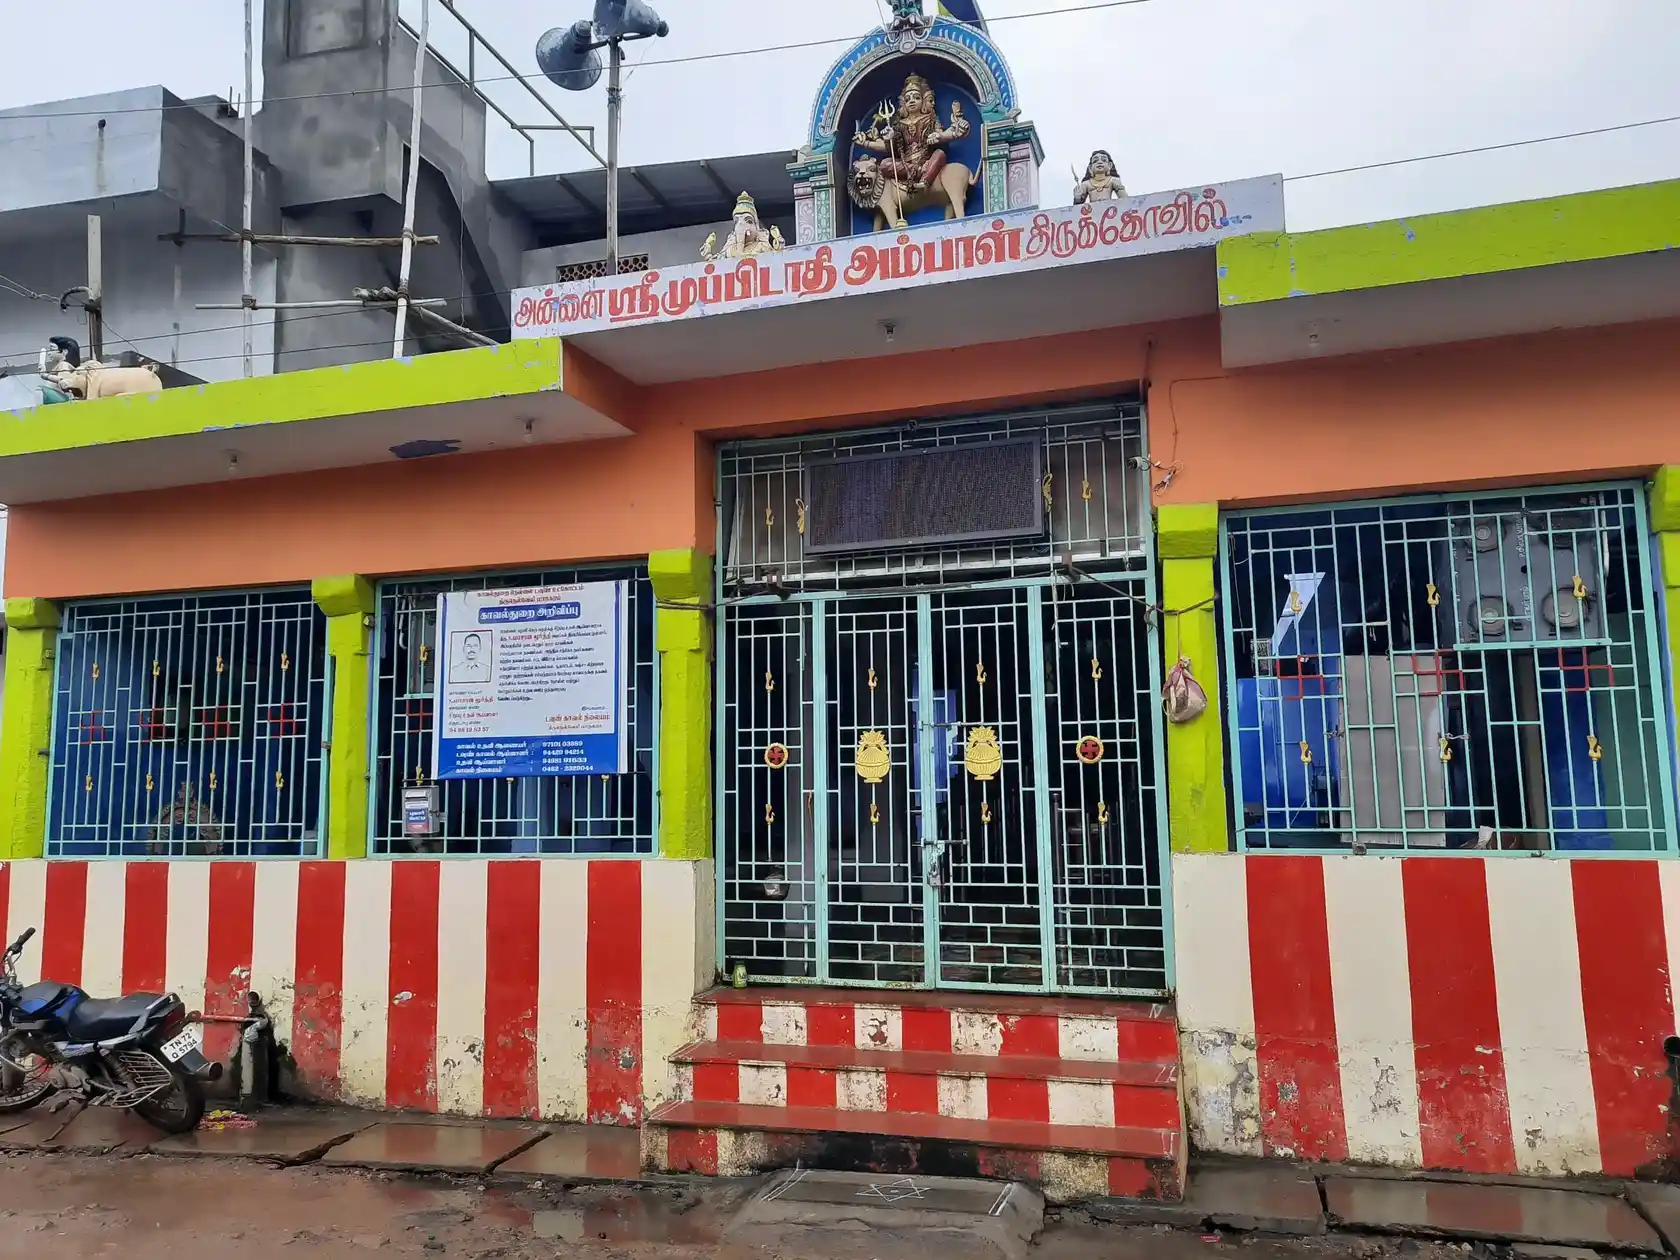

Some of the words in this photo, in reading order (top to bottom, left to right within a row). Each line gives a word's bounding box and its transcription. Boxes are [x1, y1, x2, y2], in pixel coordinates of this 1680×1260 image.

[514, 288, 604, 328] அன்னை
[844, 219, 1024, 286] அம்பாள்
[1022, 188, 1228, 261] திருக்கோவில்
[480, 608, 535, 621] காவல்துறை
[537, 605, 578, 617] அறிவிப்பு
[169, 1039, 182, 1050] TN
[181, 1032, 192, 1041] 72
[179, 1039, 198, 1054] 5794
